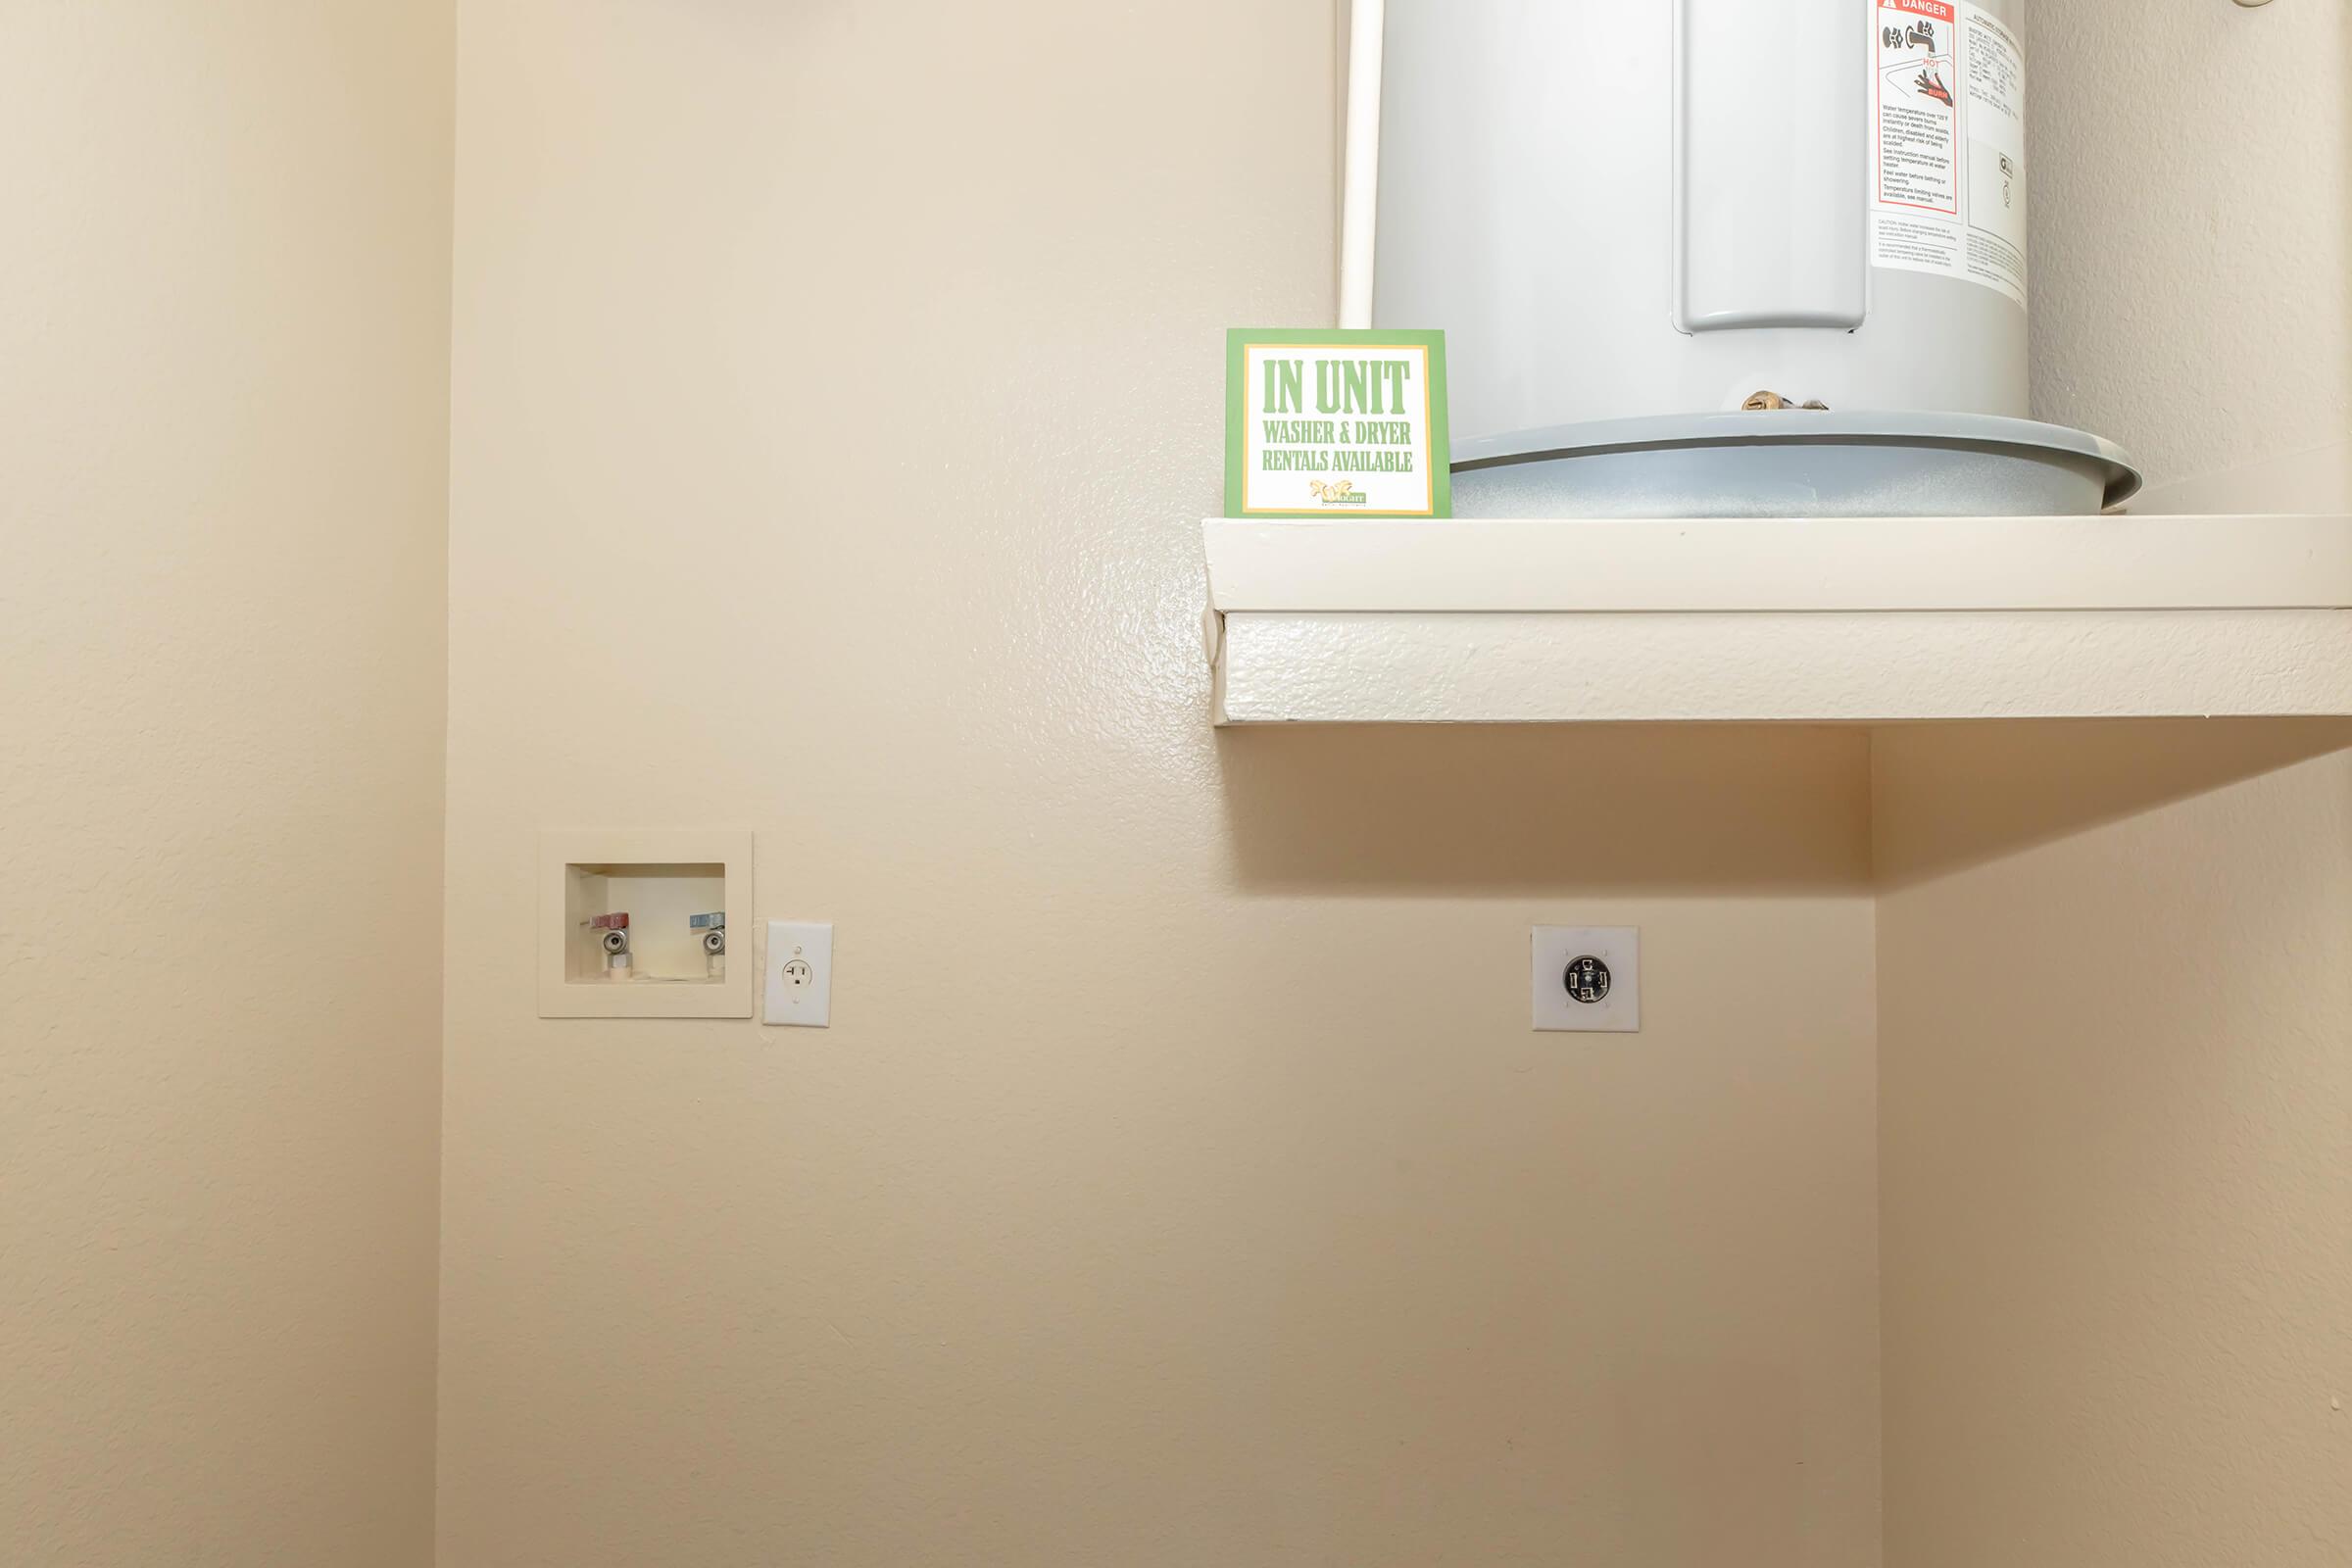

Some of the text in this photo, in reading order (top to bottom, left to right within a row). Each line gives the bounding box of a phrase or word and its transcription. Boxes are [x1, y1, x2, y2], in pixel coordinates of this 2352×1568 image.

[1902, 0, 1946, 17] DANGER
[1923, 58, 1939, 68] HOT
[1928, 88, 1948, 99] BURN
[1898, 107, 1926, 116] temperature
[1883, 126, 1905, 134] Children,
[1906, 129, 1925, 138] disabled
[1935, 135, 1949, 144] elderly
[1931, 140, 1943, 149] being
[1893, 149, 1919, 157] instruction
[1901, 157, 1928, 166] temperature
[1924, 175, 1941, 184] bathing
[1884, 184, 1913, 193] Temperature
[1914, 188, 1931, 197] limiting
[1262, 360, 1411, 415] IN UNIT
[1262, 420, 1412, 445] WASHER & DRYER
[1262, 450, 1413, 472] RENTALS AVAILABLE
